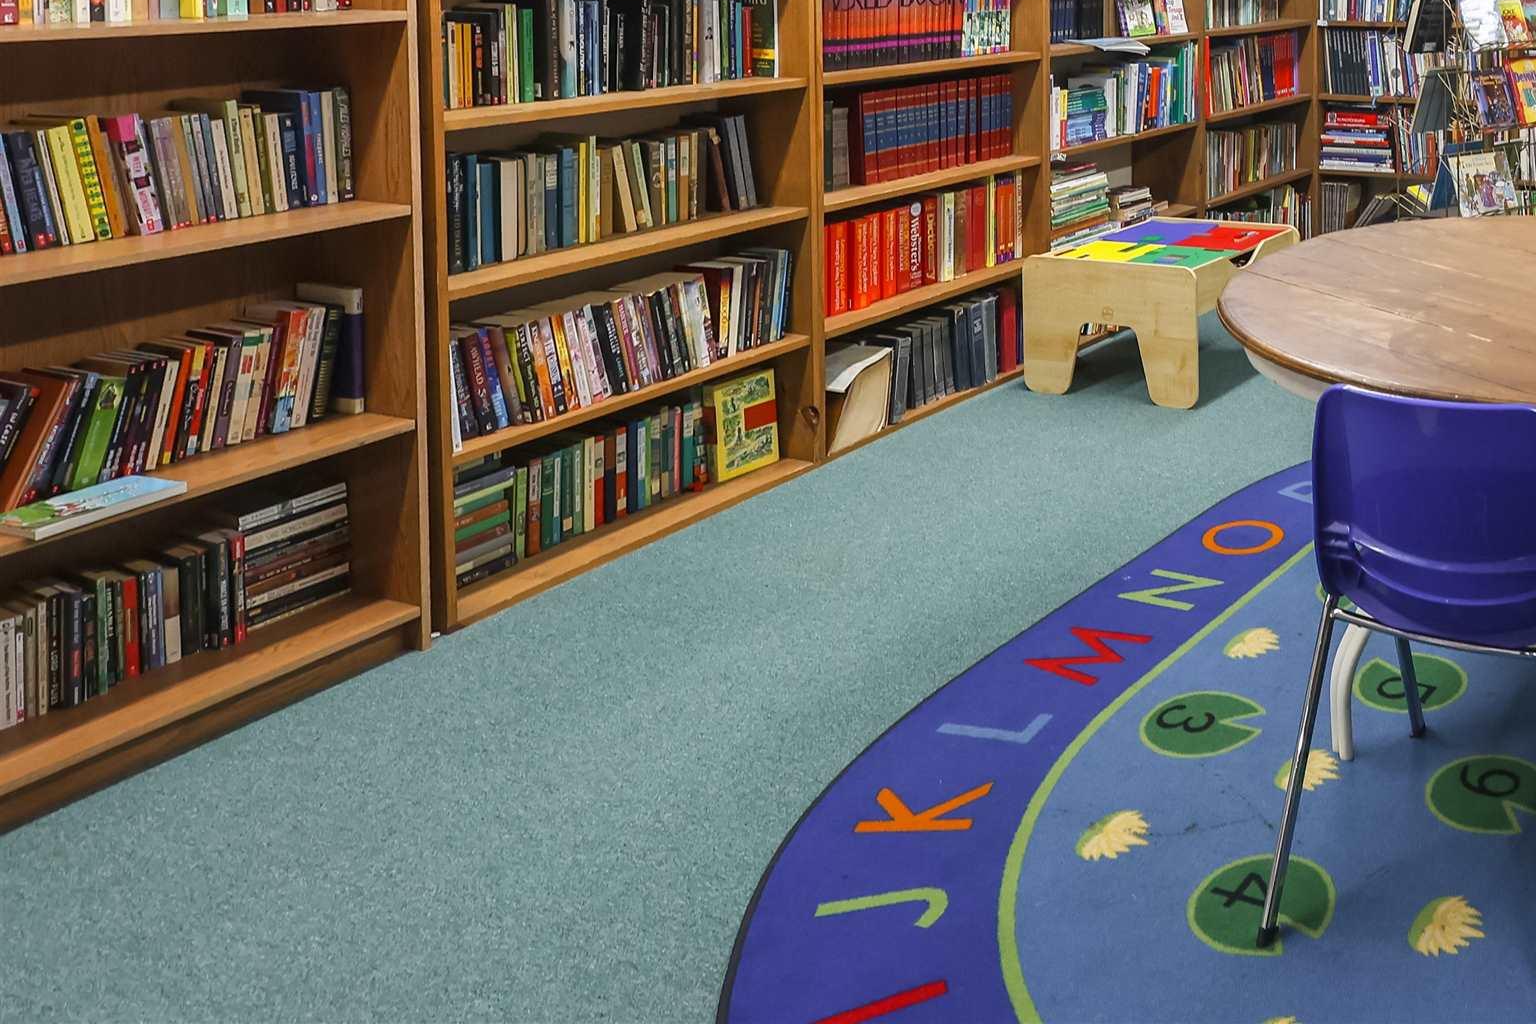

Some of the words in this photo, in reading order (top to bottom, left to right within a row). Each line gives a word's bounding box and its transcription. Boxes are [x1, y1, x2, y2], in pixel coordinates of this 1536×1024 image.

[910, 216, 920, 271] Webster's
[1202, 520, 1283, 555] O
[1117, 568, 1224, 611] N
[1025, 626, 1152, 686] M
[937, 713, 1053, 744] L
[1156, 702, 1217, 734] 3
[854, 781, 993, 833] K
[815, 886, 949, 929] J
